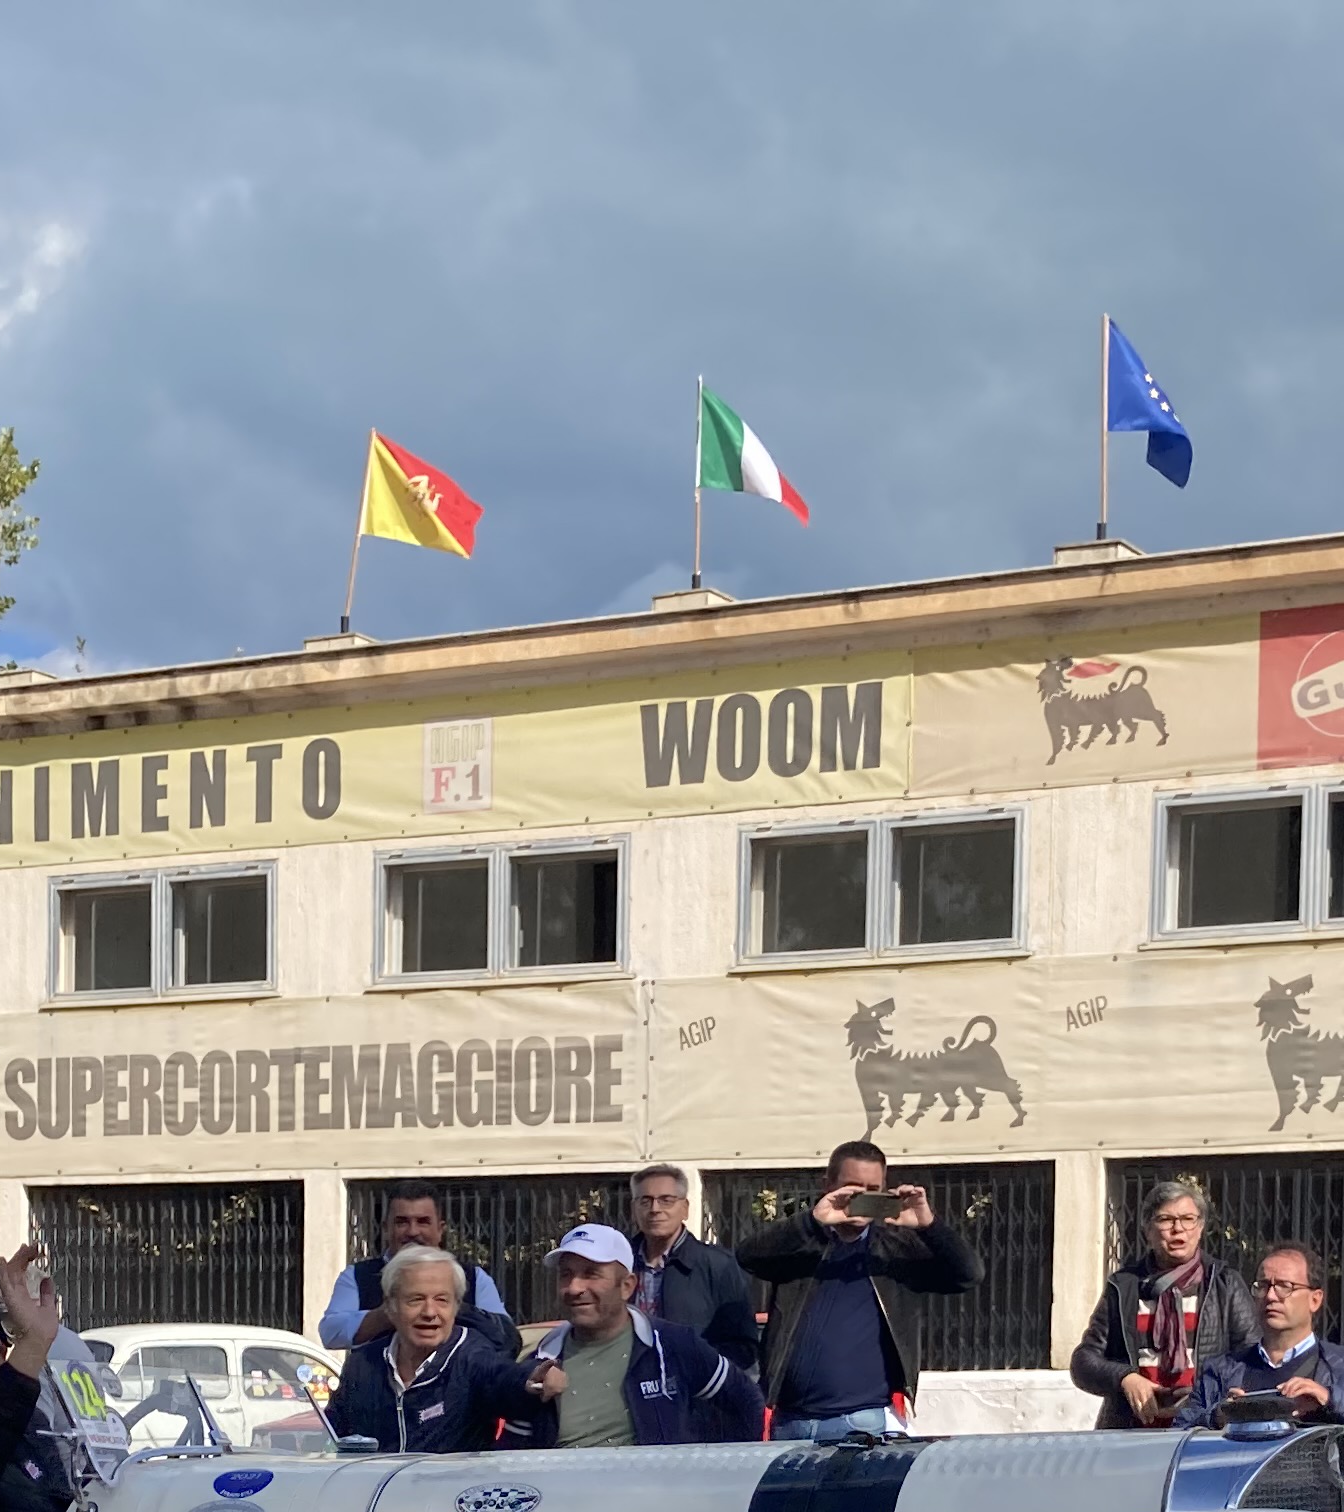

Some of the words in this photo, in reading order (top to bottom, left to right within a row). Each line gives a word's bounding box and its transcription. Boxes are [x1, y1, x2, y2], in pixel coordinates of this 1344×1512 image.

[430, 723, 484, 764] AGIP
[639, 681, 883, 789] WOOM
[430, 764, 484, 804] F.1
[678, 1016, 717, 1052] AGIP
[1066, 995, 1109, 1033] AGIP
[4, 1034, 623, 1141] SUPERCORTEMAGGIORE
[60, 1368, 107, 1421] 124
